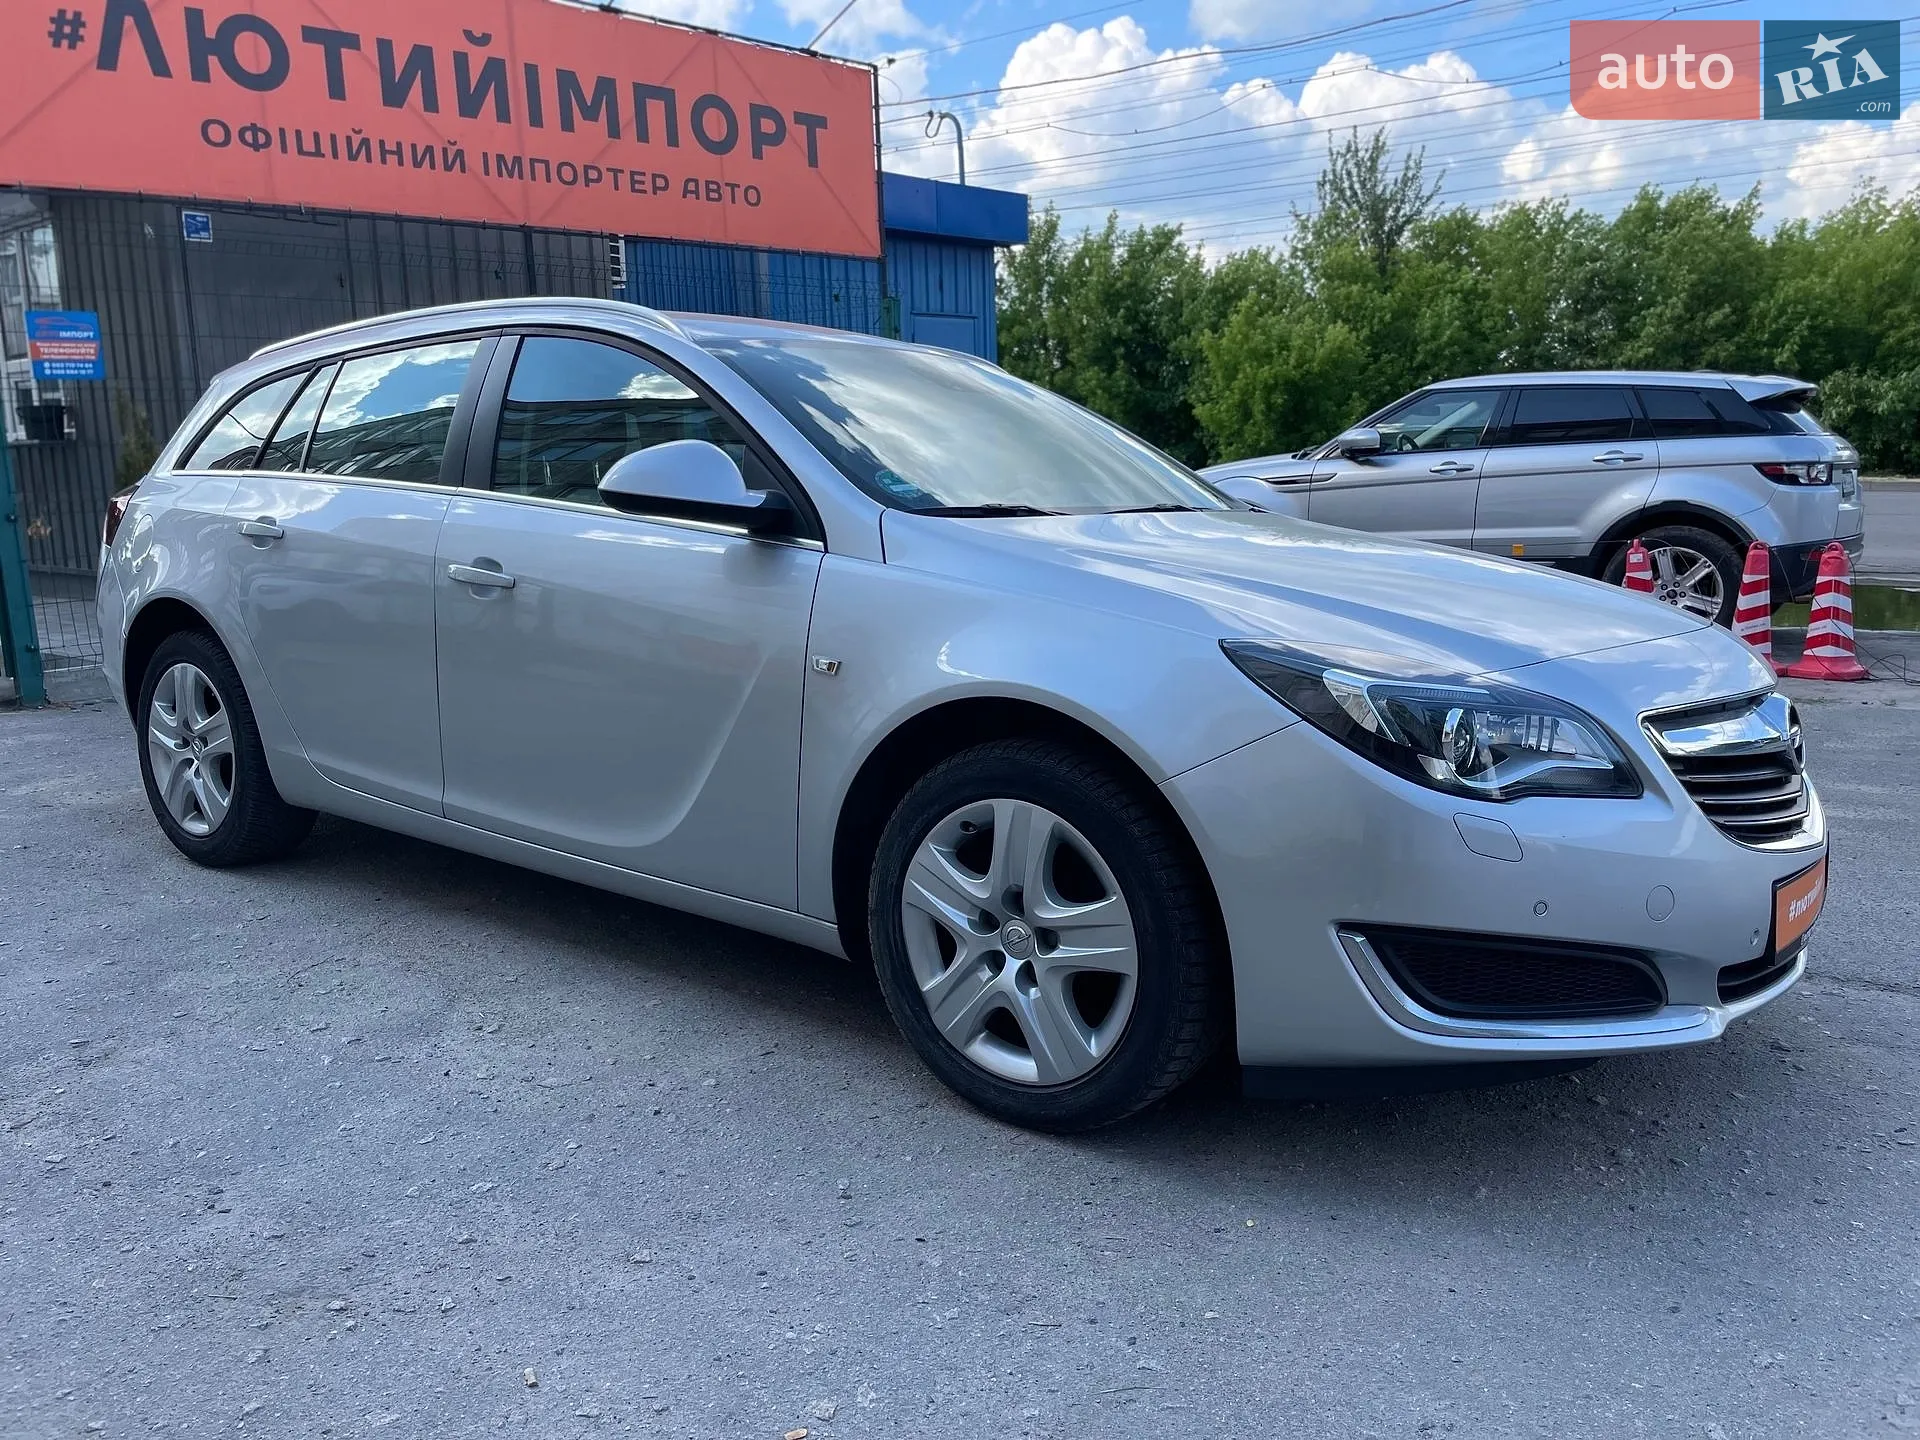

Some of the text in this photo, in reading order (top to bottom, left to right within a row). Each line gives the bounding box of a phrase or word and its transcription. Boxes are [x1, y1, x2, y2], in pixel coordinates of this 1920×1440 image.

[48, 0, 829, 168] #ЛЮТИЙІМПОРТ
[201, 118, 762, 207] ОФІЦІЙНИЙ ІМПОРТЕР АВТО
